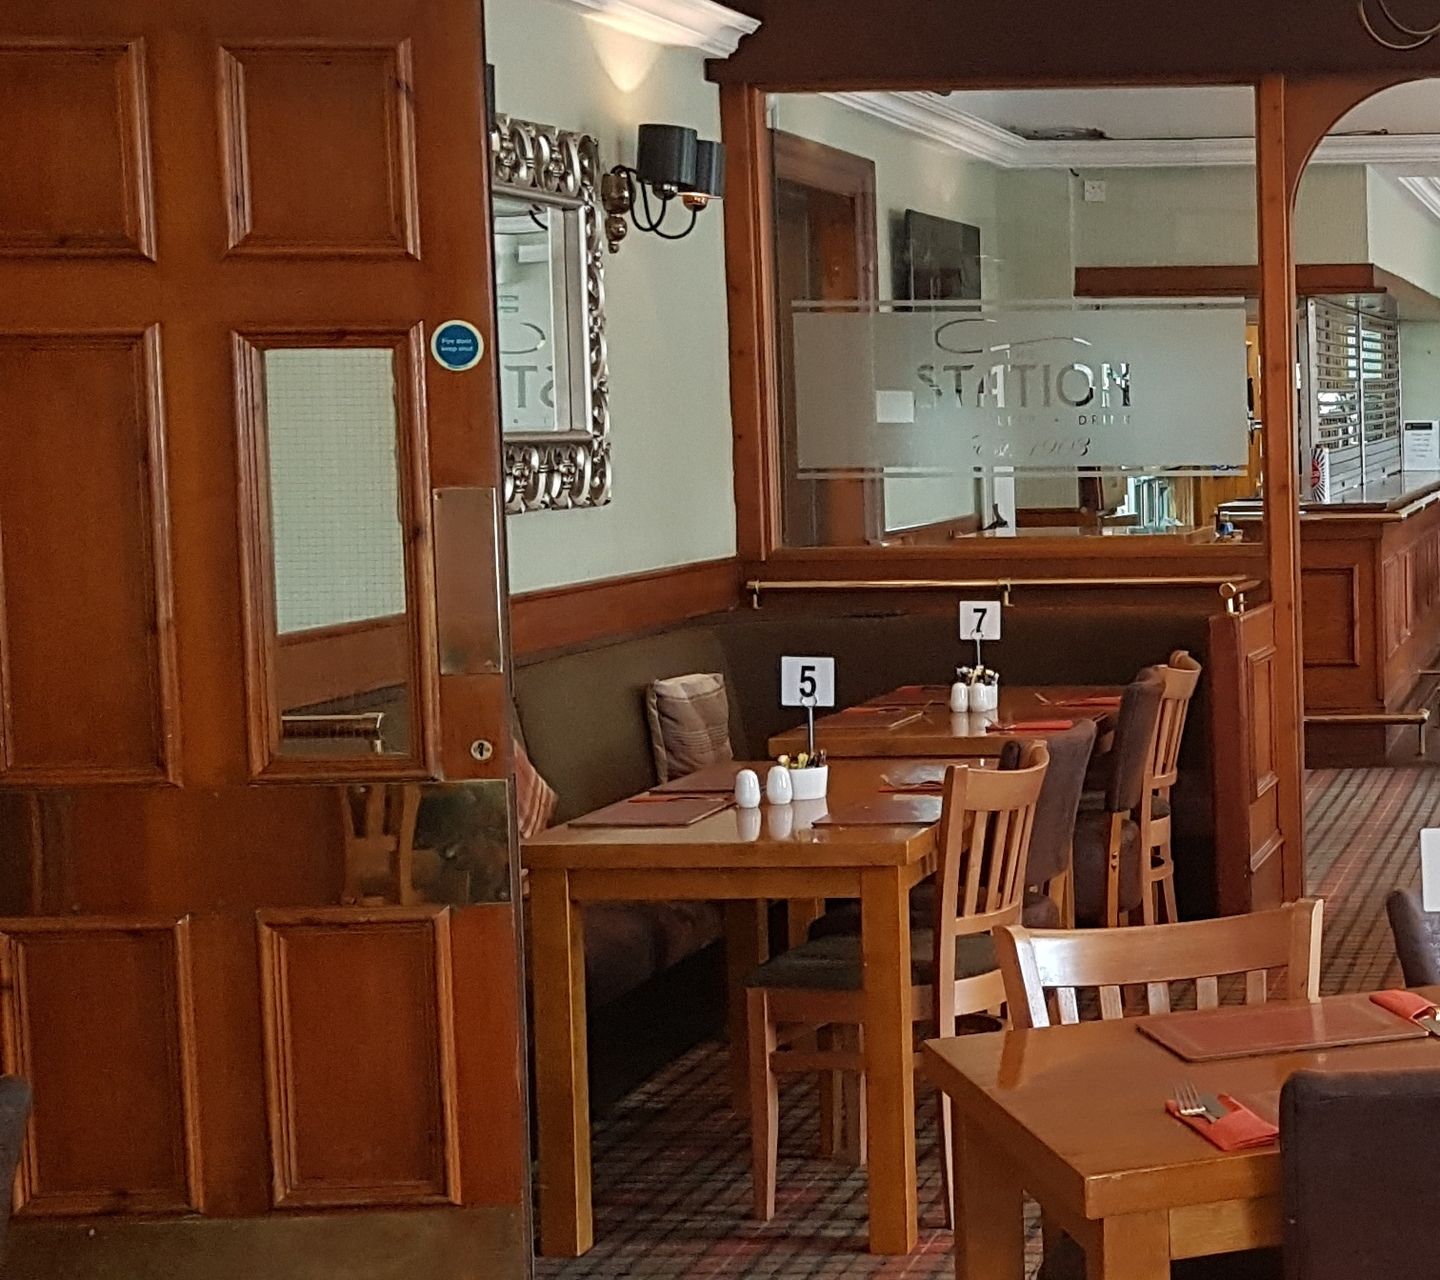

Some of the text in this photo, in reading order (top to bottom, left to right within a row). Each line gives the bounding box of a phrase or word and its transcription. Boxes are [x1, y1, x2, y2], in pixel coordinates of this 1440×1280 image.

[916, 363, 1132, 408] STATION
[973, 608, 987, 633] 7
[800, 665, 817, 697] 5
